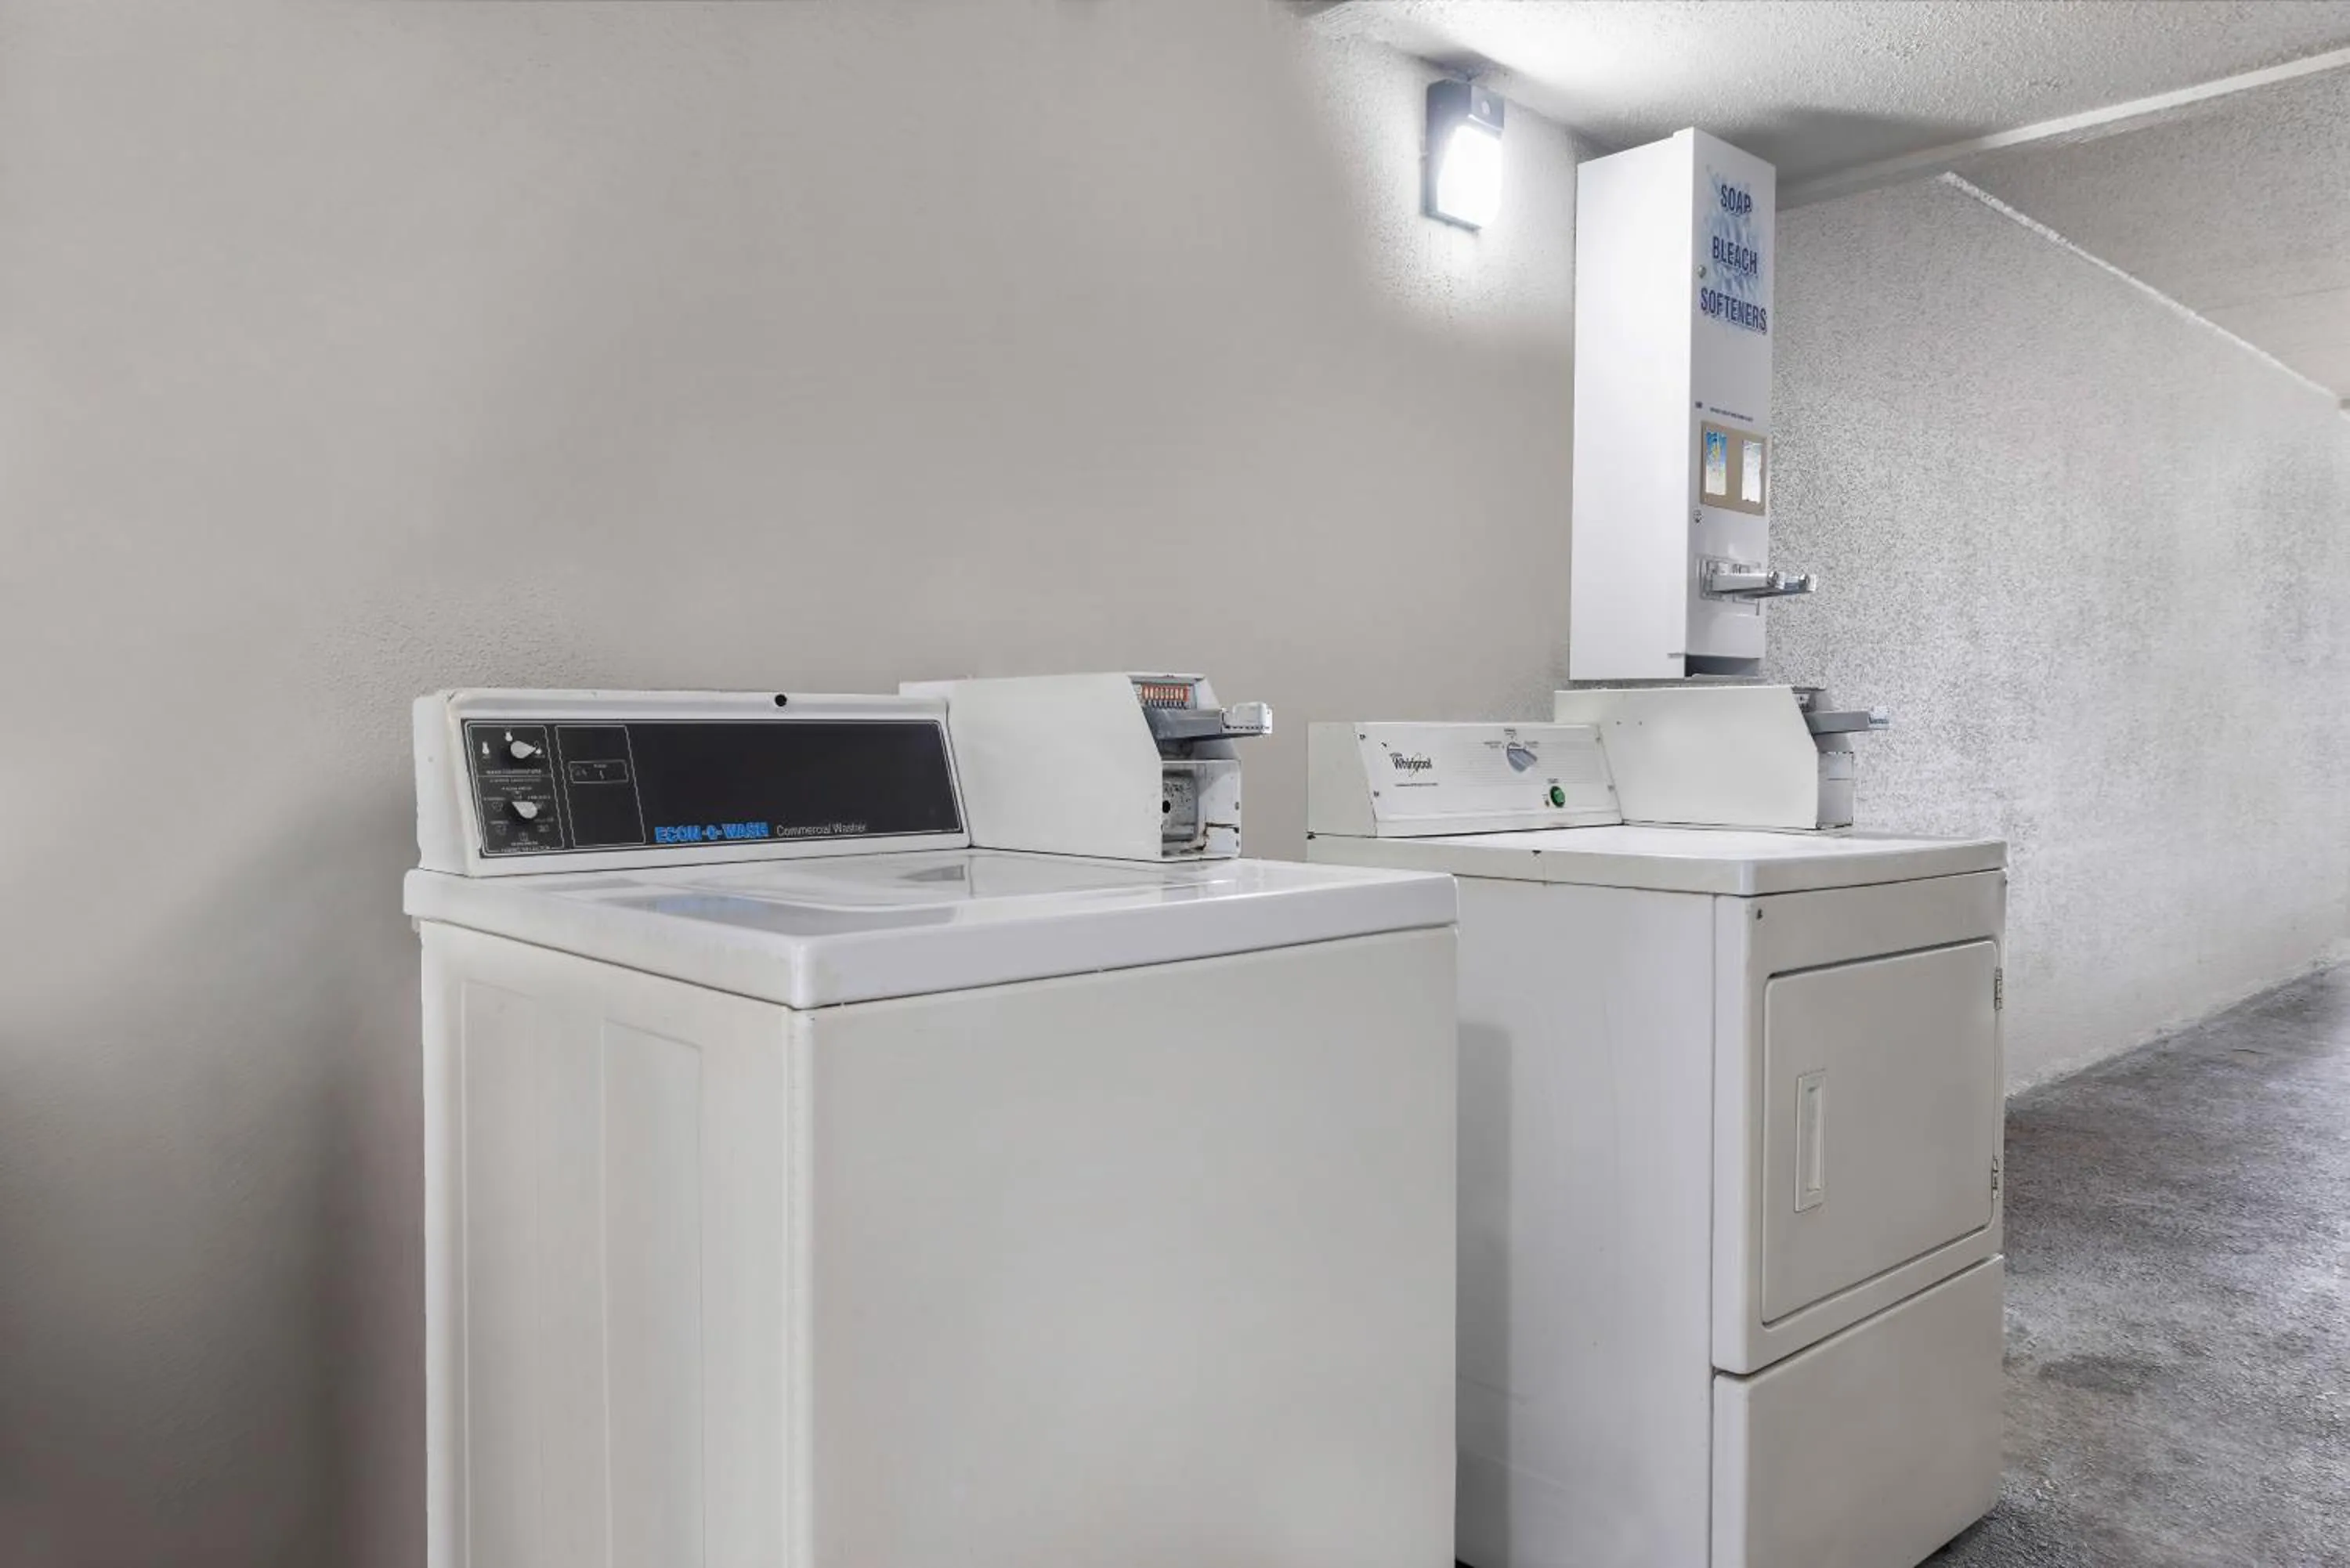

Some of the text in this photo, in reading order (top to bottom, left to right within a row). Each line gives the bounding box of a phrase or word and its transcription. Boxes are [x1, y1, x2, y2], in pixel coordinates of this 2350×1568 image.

[1721, 185, 1752, 214] SOAP
[1712, 237, 1757, 274] BLEACH
[1701, 287, 1767, 331] SOFTENERS
